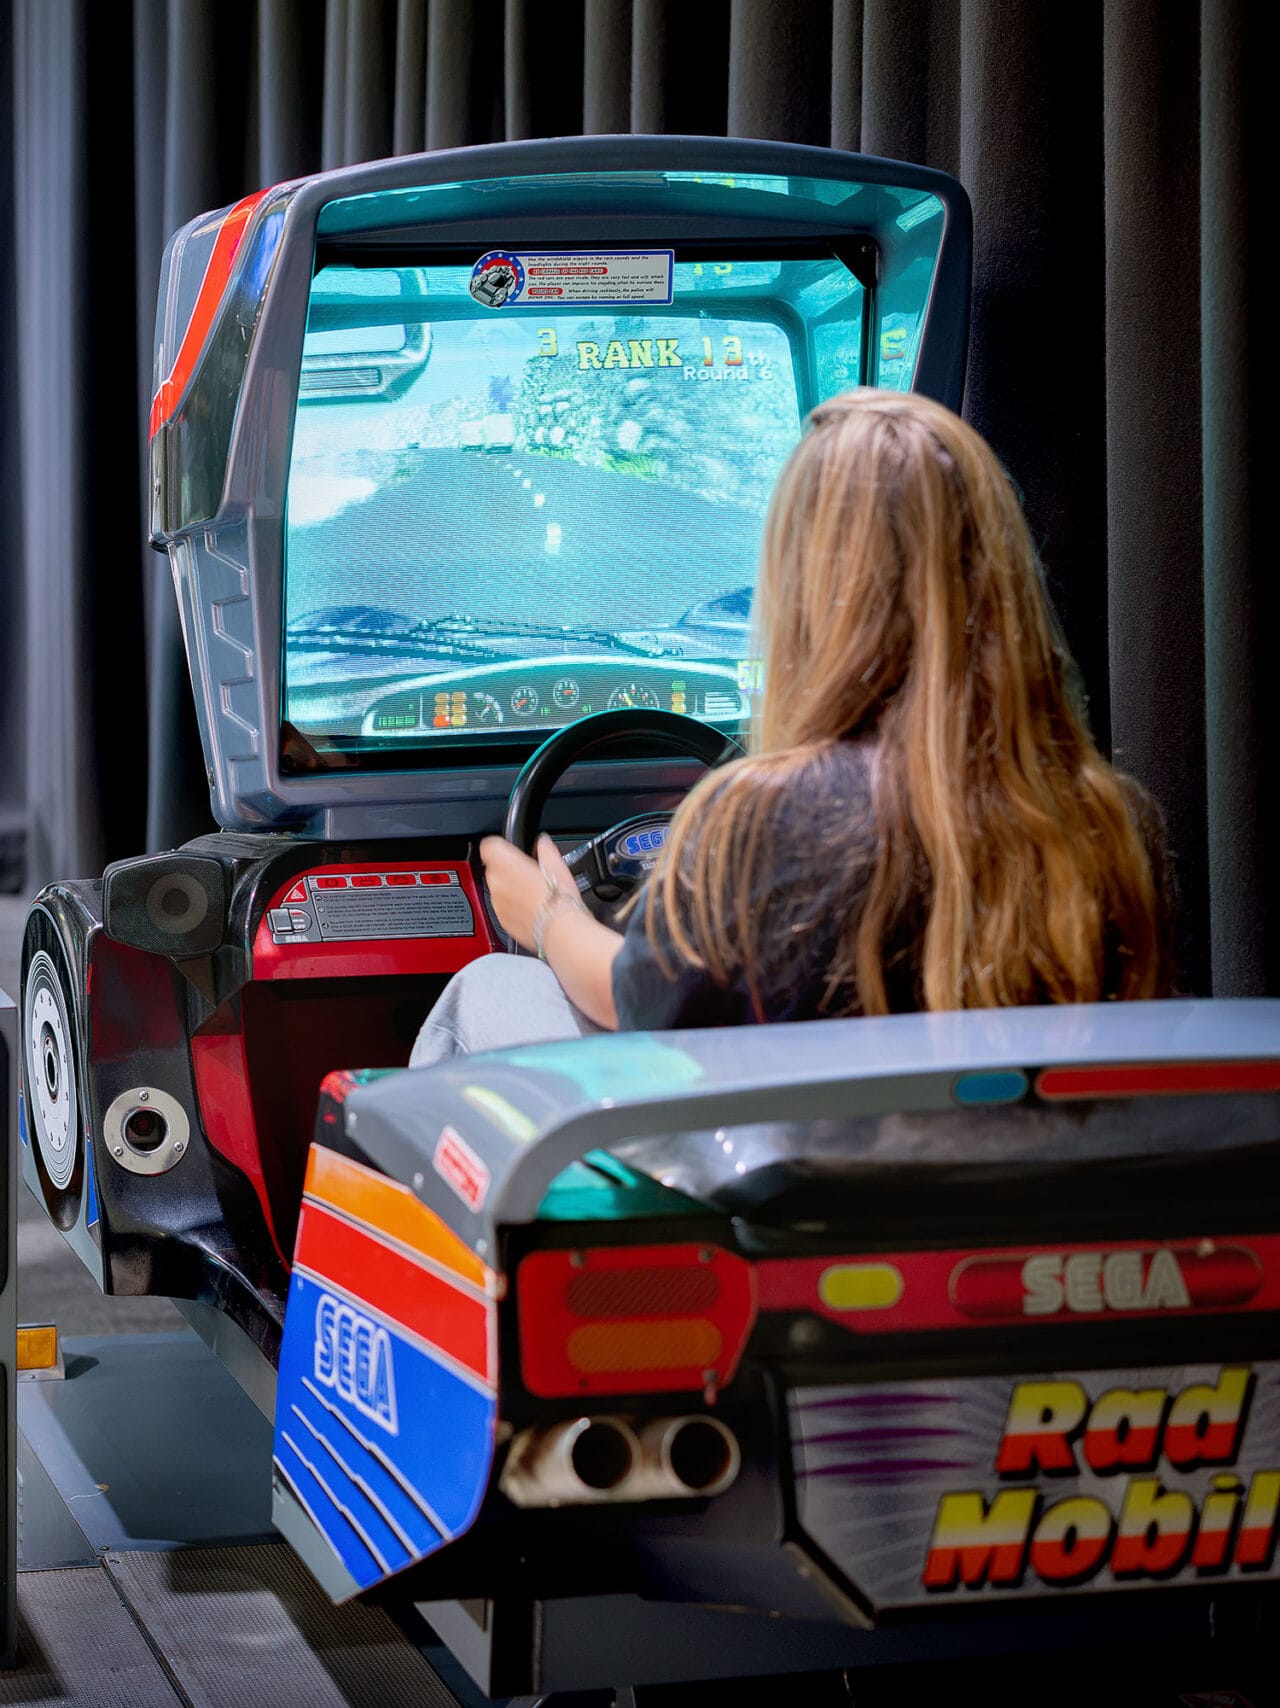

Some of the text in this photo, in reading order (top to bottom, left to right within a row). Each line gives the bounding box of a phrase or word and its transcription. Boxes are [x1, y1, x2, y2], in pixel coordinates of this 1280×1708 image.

[537, 327, 558, 358] 3
[576, 338, 684, 370] RANK
[702, 335, 745, 367] 13
[683, 366, 749, 382] Round
[1022, 1249, 1191, 1316] SEGA
[314, 1293, 400, 1438] SEGA
[994, 1366, 1258, 1481] Rad
